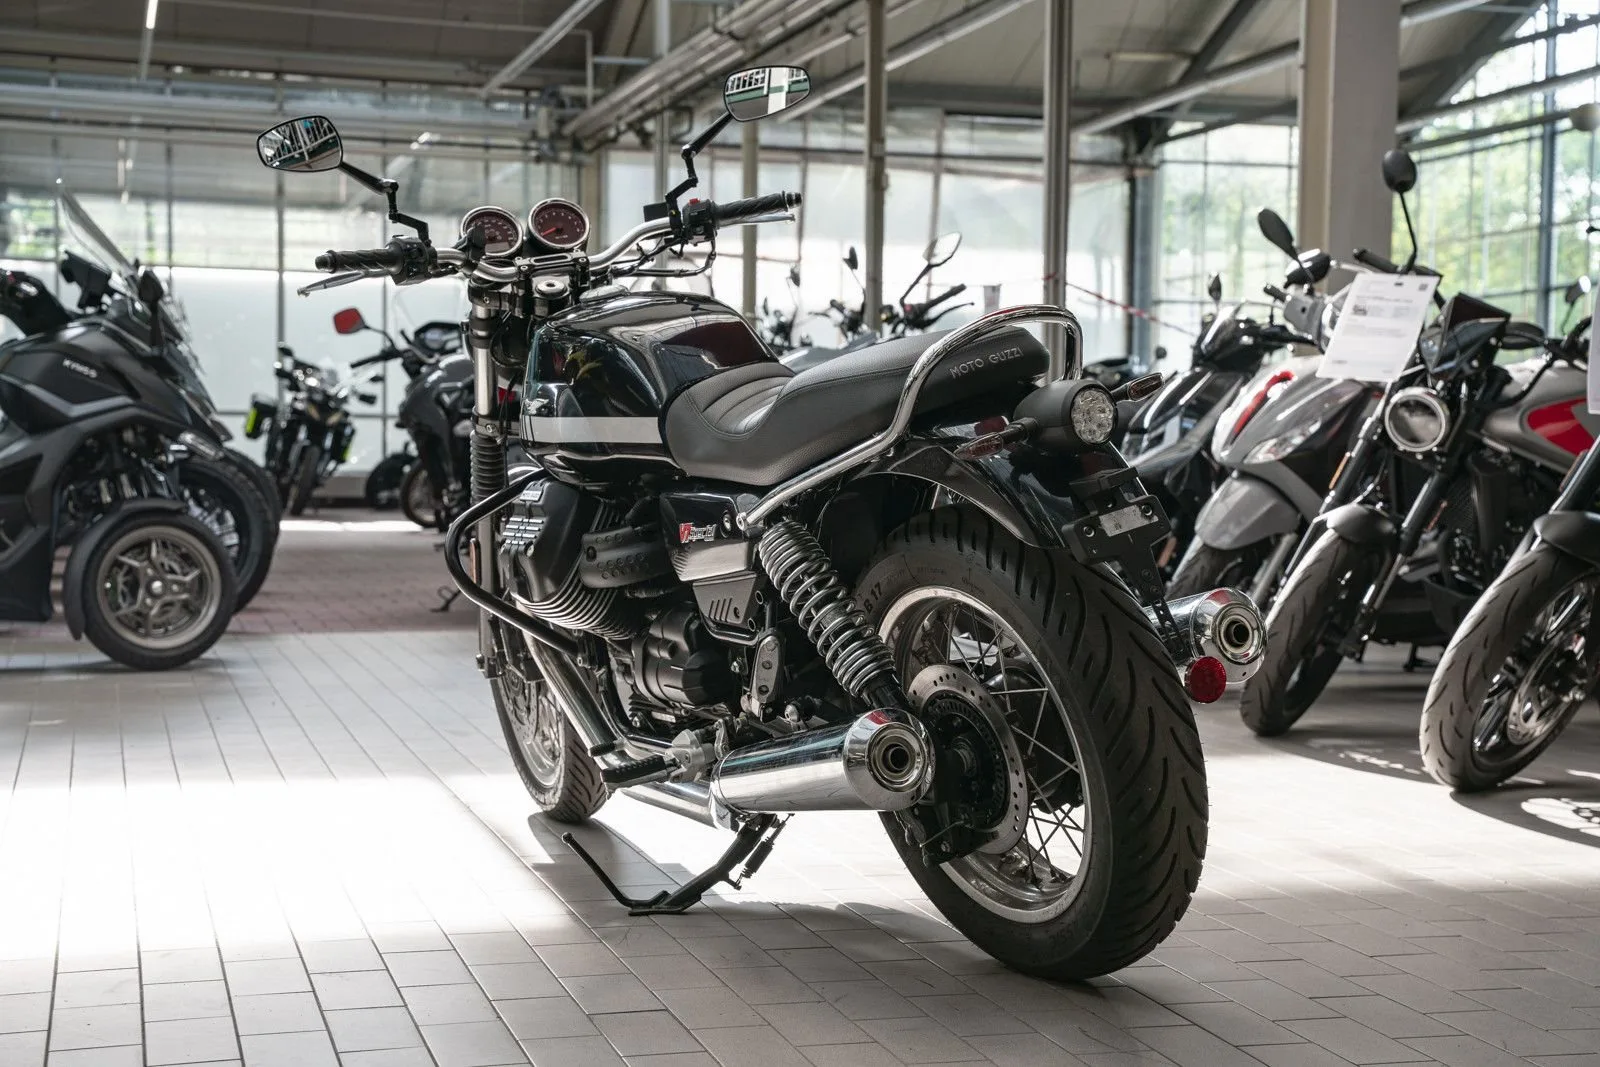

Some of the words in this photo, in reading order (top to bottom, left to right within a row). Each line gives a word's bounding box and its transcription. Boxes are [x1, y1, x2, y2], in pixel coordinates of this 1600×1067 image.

[949, 358, 985, 379] MOTO
[988, 347, 1024, 364] GUZZI
[871, 581, 882, 600] 17
